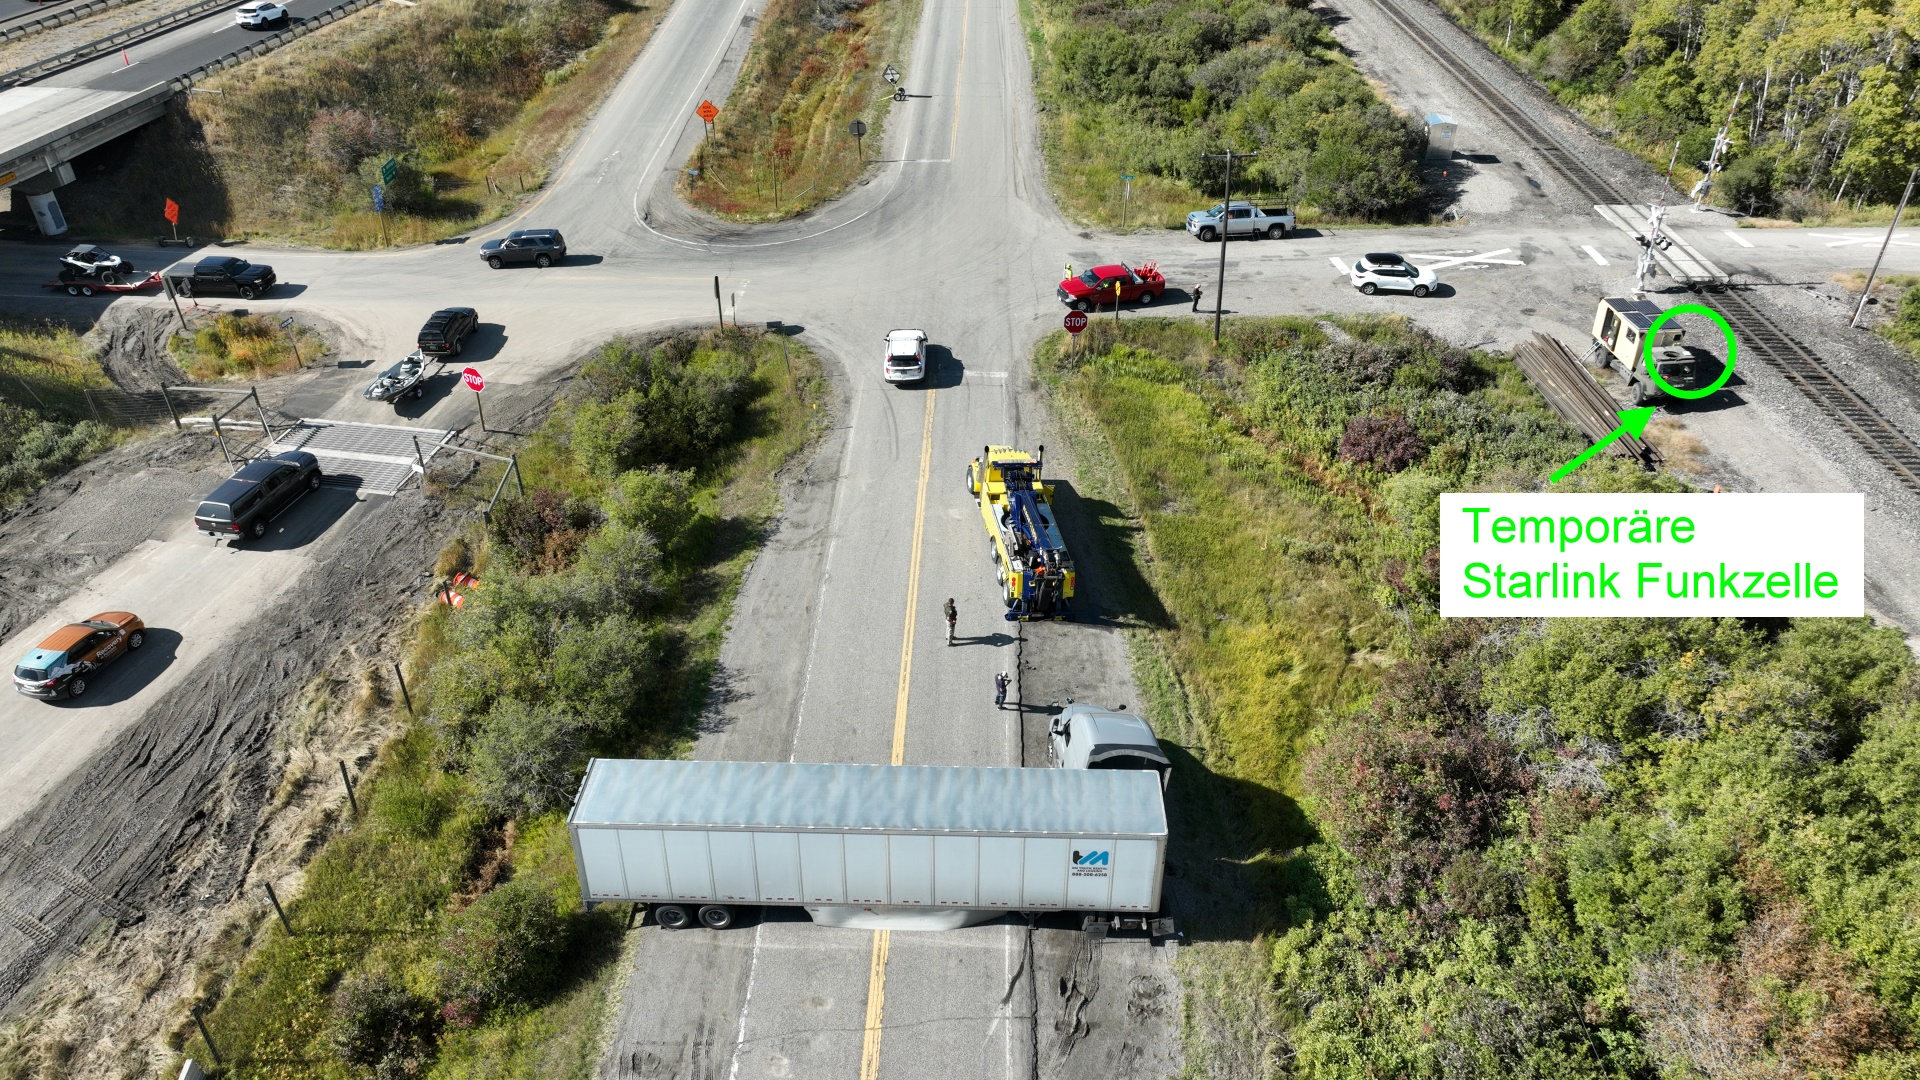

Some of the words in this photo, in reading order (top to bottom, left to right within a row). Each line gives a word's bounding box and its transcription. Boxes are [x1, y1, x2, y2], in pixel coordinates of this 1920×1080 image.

[1065, 317, 1086, 327] STOP
[463, 373, 483, 386] STOP
[96, 635, 122, 658] Recovery
